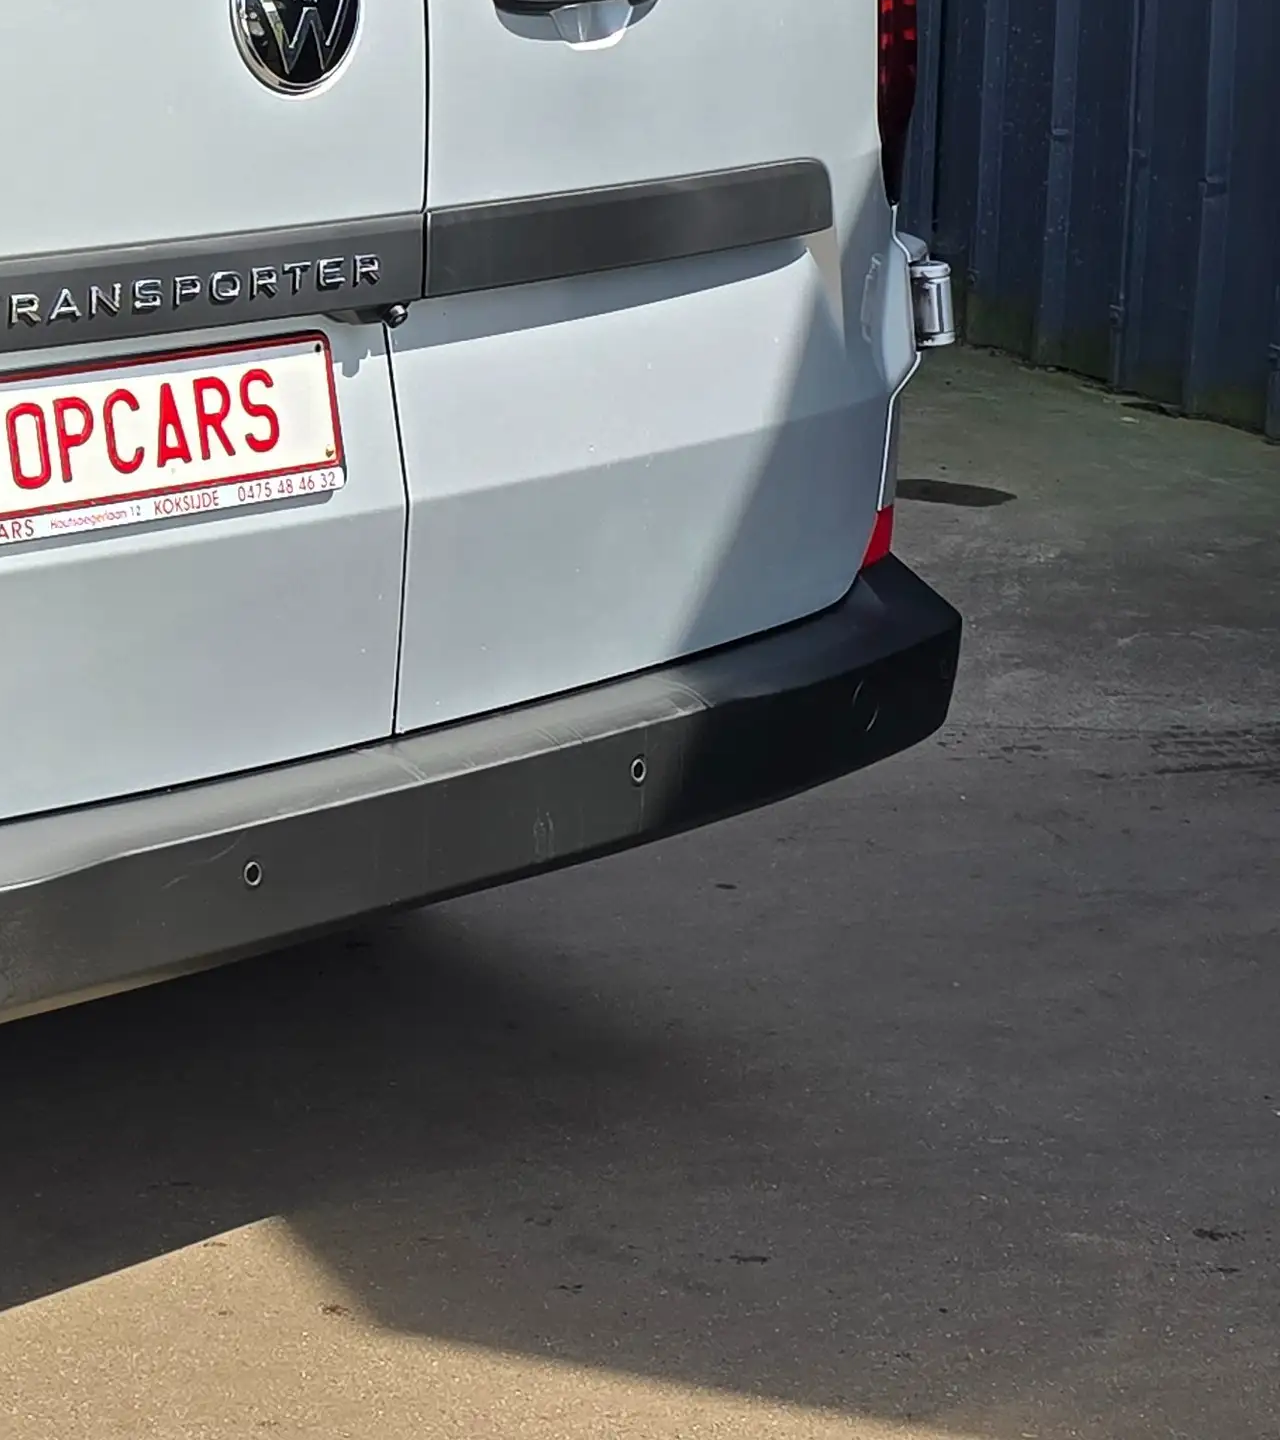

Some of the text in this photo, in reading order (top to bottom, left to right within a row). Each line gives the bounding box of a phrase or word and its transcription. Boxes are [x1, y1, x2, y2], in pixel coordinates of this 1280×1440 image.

[153, 490, 220, 516] KOKSIJDE
[237, 480, 273, 503] 0475
[277, 478, 294, 494] 48
[298, 475, 316, 491] 46
[321, 471, 337, 489] 32
